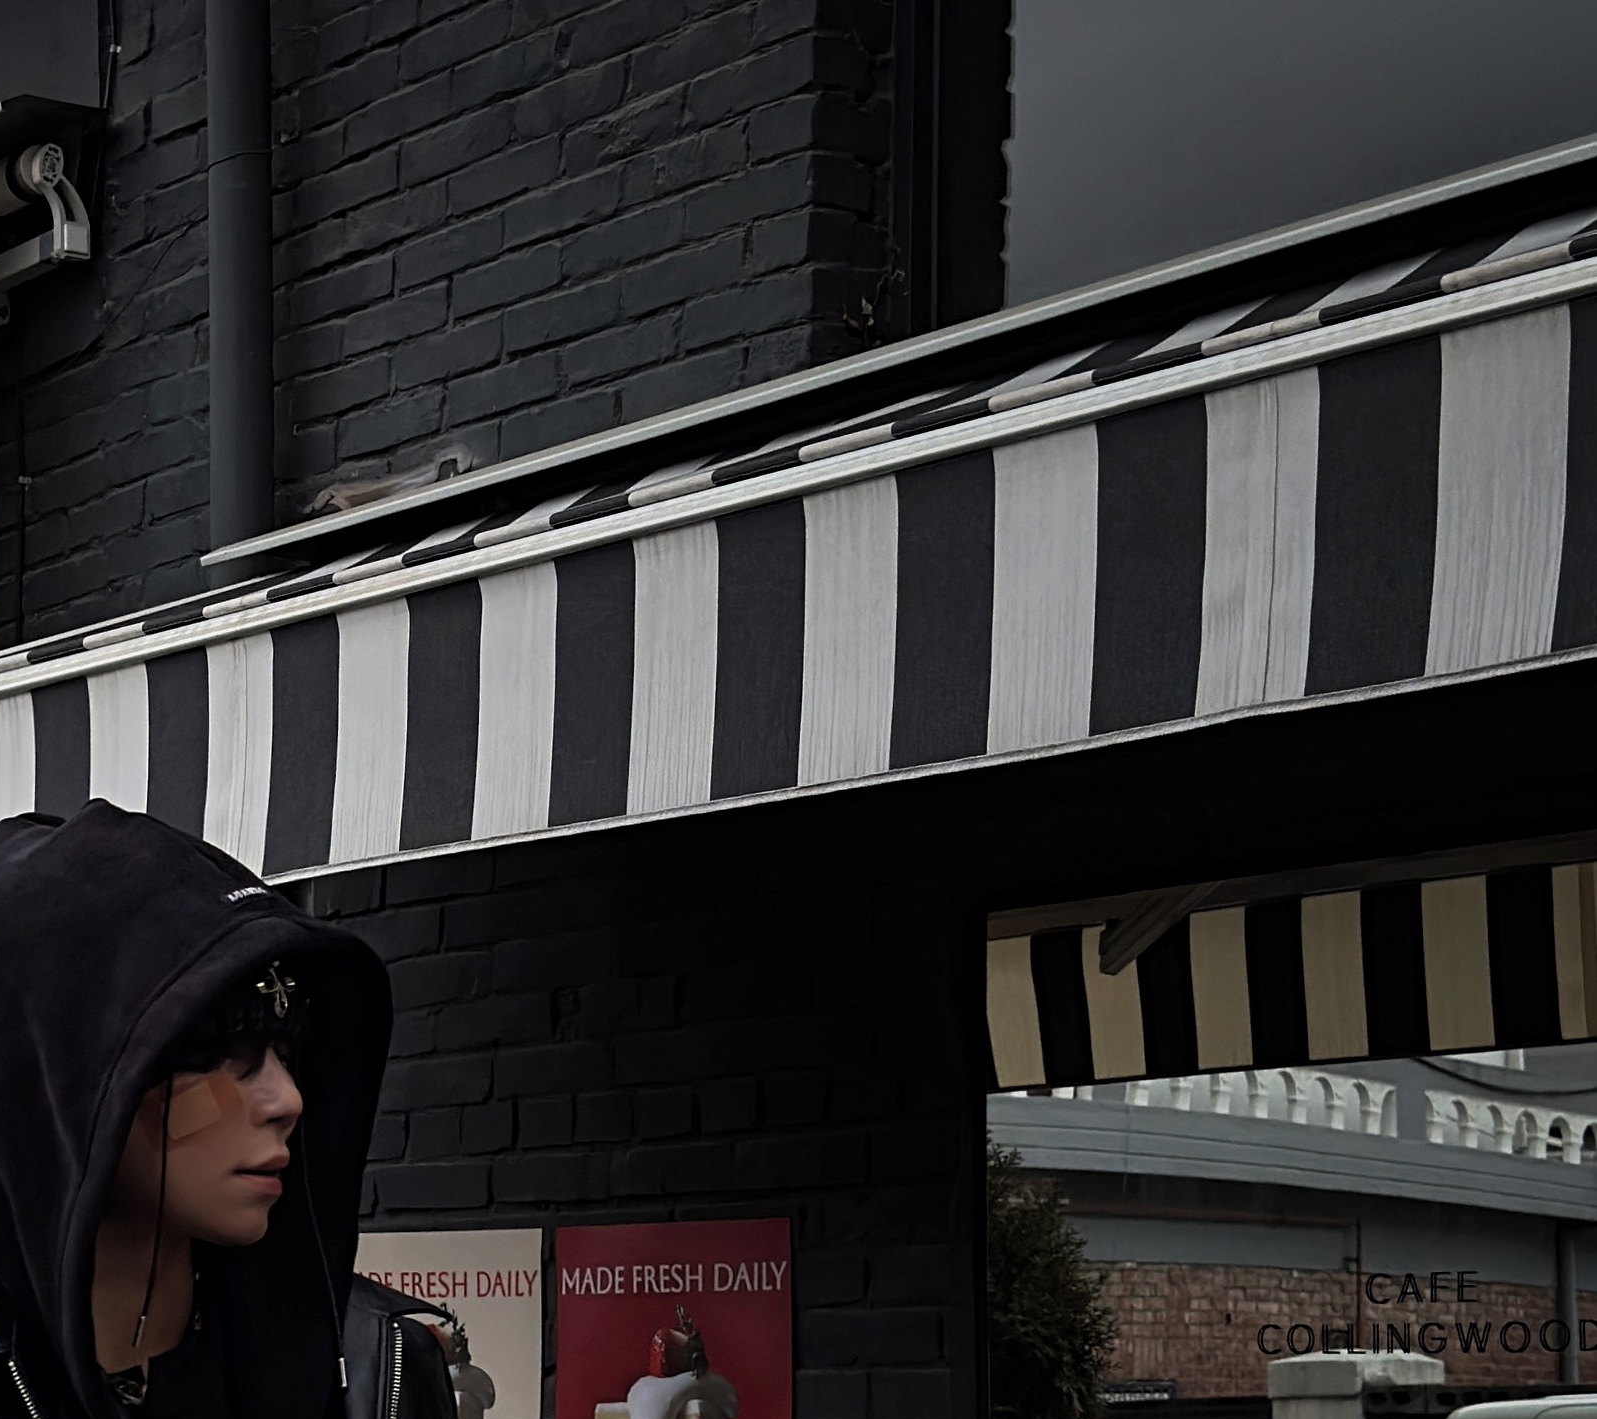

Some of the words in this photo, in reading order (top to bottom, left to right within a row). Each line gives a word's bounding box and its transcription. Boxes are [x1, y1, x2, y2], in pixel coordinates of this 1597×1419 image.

[400, 1271, 468, 1298] FRESH
[477, 1269, 538, 1298] DAILY
[561, 1265, 625, 1296] MADE
[631, 1263, 703, 1294] FRESH
[712, 1260, 788, 1292] DAILY
[1365, 1271, 1478, 1305] CAFE
[1257, 1318, 1597, 1355] COLLINGWOOD
